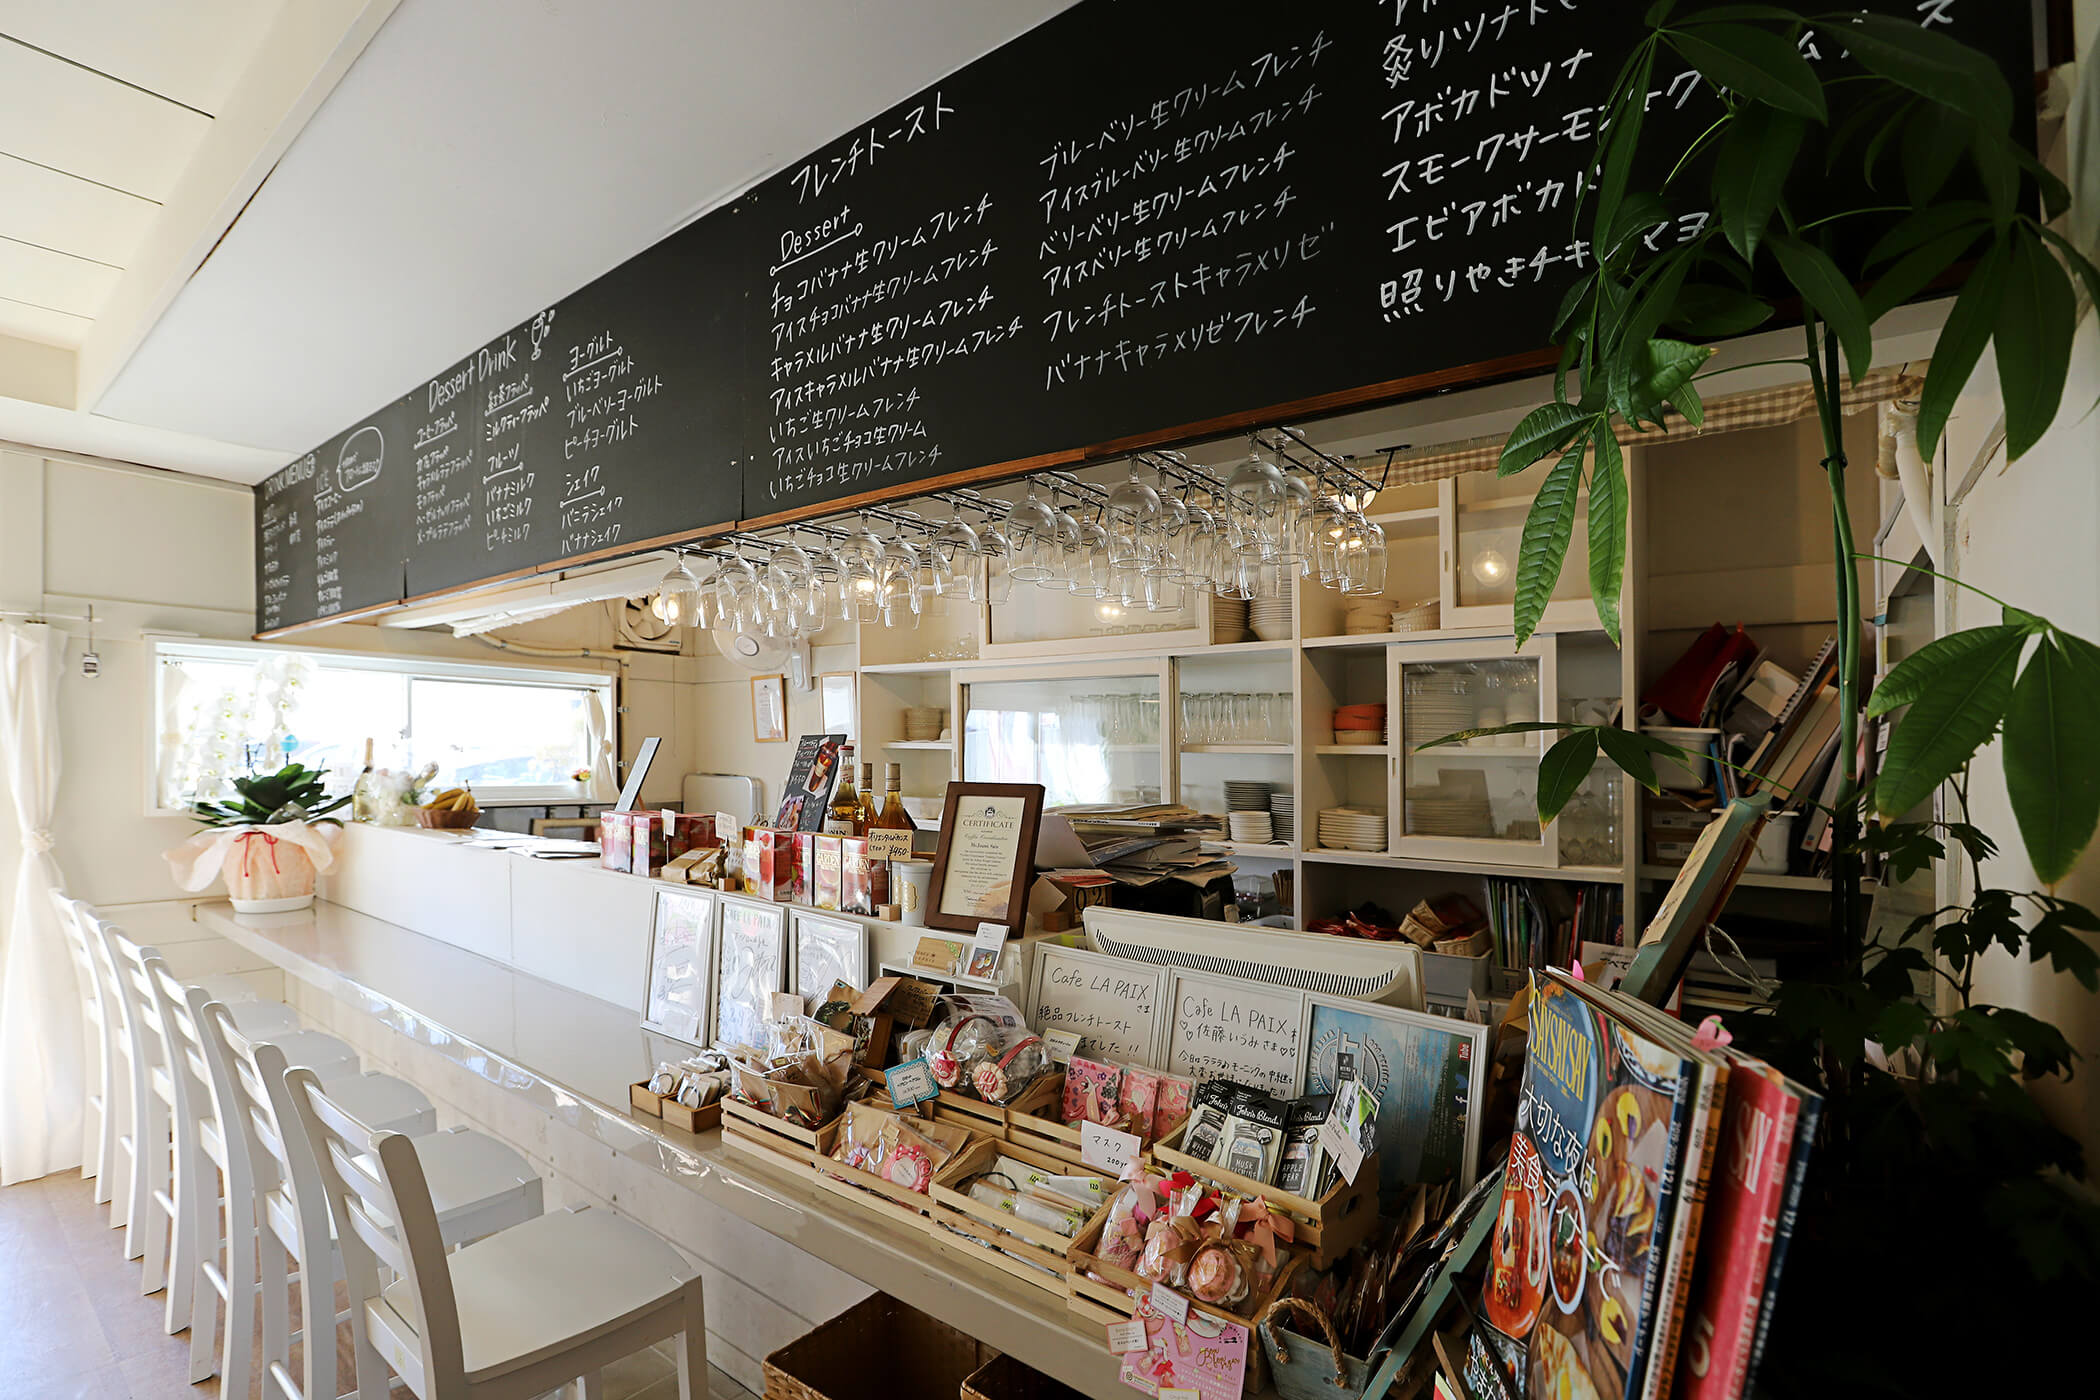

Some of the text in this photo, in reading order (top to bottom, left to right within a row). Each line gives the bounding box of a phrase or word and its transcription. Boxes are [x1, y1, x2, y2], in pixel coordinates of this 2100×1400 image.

[1039, 29, 1333, 181] ブルーベリー生クリームフレンチ
[1381, 48, 1593, 144] アボカドツナ
[790, 90, 955, 205] フレンチトースト
[1039, 83, 1323, 225] アイスブルーベリー生クリームフレンチ
[1039, 141, 1296, 260] ベリーベリー生クリームフレンチ
[771, 192, 993, 318] チョコバナナ生クリームフレンチ
[780, 205, 850, 262] Dessert
[1042, 185, 1297, 297] アイスベリー生クリームフレンチ
[771, 238, 998, 351] アイスチョコバナナ生クリームフレンチ
[1042, 221, 1335, 343] フレンチトーストキャラメリゼ
[569, 330, 614, 371] ヨーグルト
[770, 285, 994, 382] キャラメルバナナ生クリームフレンチ
[1046, 294, 1316, 392] バナナキャラメリゼフレンチ
[428, 335, 517, 414] Dessert Drink
[565, 355, 635, 402] いちごヨーグルト
[769, 315, 1023, 416] アイスキャラメルバナナ生クリームフレンチ
[566, 374, 663, 429] ブルーベリーヨーグルト
[769, 386, 920, 443] いちご生クリームフレンチ
[487, 443, 520, 472] フルーツ
[564, 414, 639, 460] ピーチヨーグルト
[772, 420, 927, 471] アイスいちごチョコ生クリーム
[486, 472, 535, 507] バナナミルク
[565, 465, 600, 496] シェイク
[769, 443, 943, 500] いちごチョコ生クリームフレンチ
[486, 498, 532, 526] いちごミルク
[561, 496, 623, 529] バニラシェイク
[561, 524, 621, 555] バナナシェイク
[1051, 967, 1150, 1001] Cafe LA PAIX
[1038, 1004, 1132, 1035] 絶品フレンチトースト
[1182, 995, 1288, 1035] Cafe LA PAIX
[1092, 1135, 1122, 1152] マスク
[1236, 1159, 1254, 1170] MUSK
[1282, 1163, 1303, 1173] APPLE
[1521, 1084, 1597, 1201] 大切な夜は
[1282, 1173, 1300, 1182] PEAR
